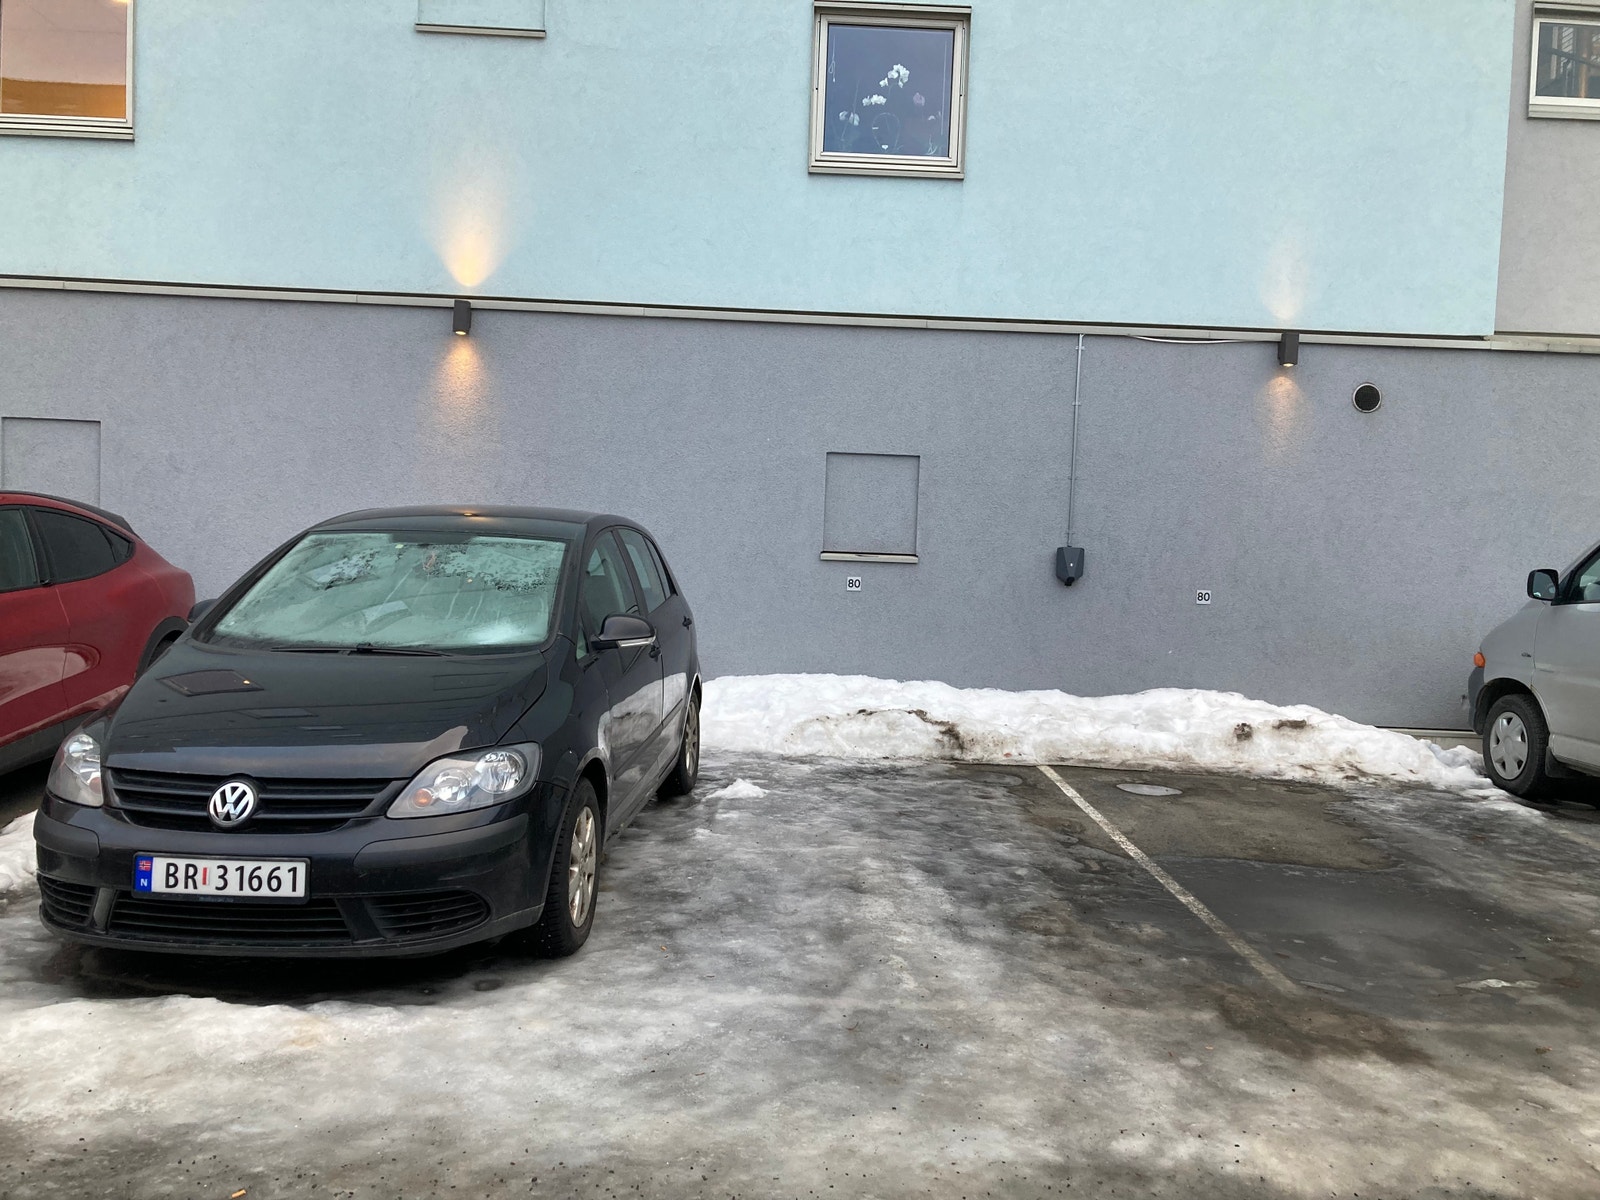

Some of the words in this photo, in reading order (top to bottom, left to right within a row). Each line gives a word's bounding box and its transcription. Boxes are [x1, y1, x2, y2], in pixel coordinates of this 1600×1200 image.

[848, 578, 861, 588] 80
[1197, 592, 1210, 601] 80
[165, 862, 198, 890] BR
[215, 864, 298, 893] 31661
[140, 878, 148, 887] N
